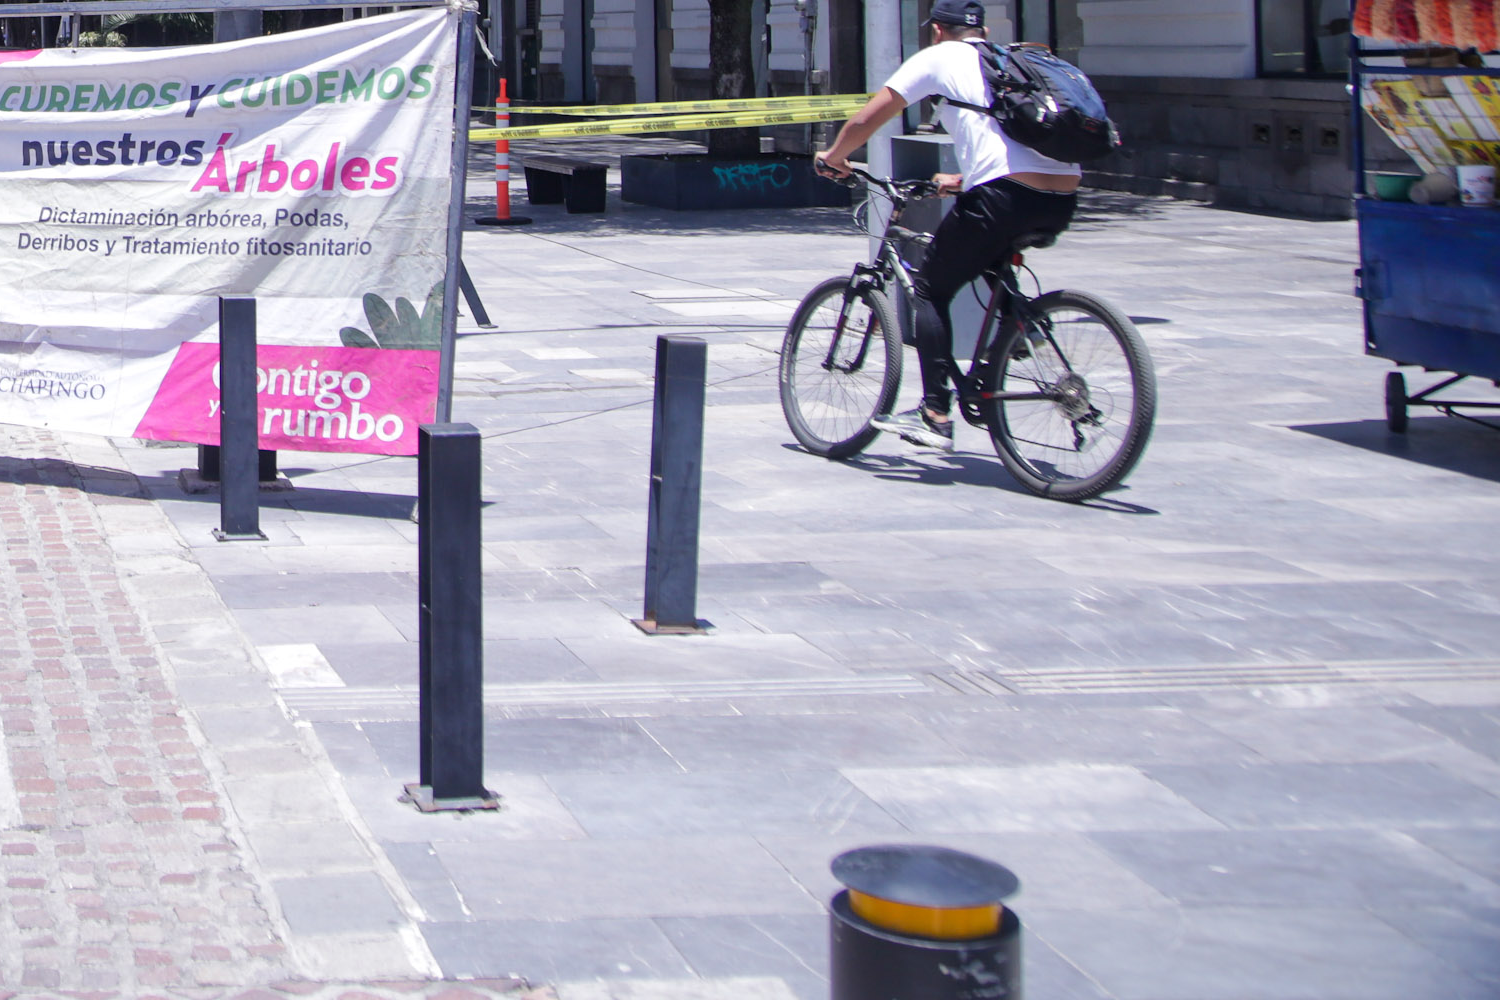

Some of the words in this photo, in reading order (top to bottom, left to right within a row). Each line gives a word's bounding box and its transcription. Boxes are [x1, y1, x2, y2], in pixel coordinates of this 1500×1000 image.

[216, 64, 434, 109] CUIDEMOS
[22, 132, 205, 166] nuestros
[190, 132, 399, 192] Árboles
[38, 206, 179, 227] Dictaminación
[185, 209, 267, 230] arbórea,
[274, 208, 350, 231] Podas,
[17, 232, 99, 253] Derribos
[104, 239, 117, 257] y
[122, 235, 240, 256] Tratamiento
[246, 237, 372, 257] fitosanitario
[262, 402, 404, 442] rumbo
